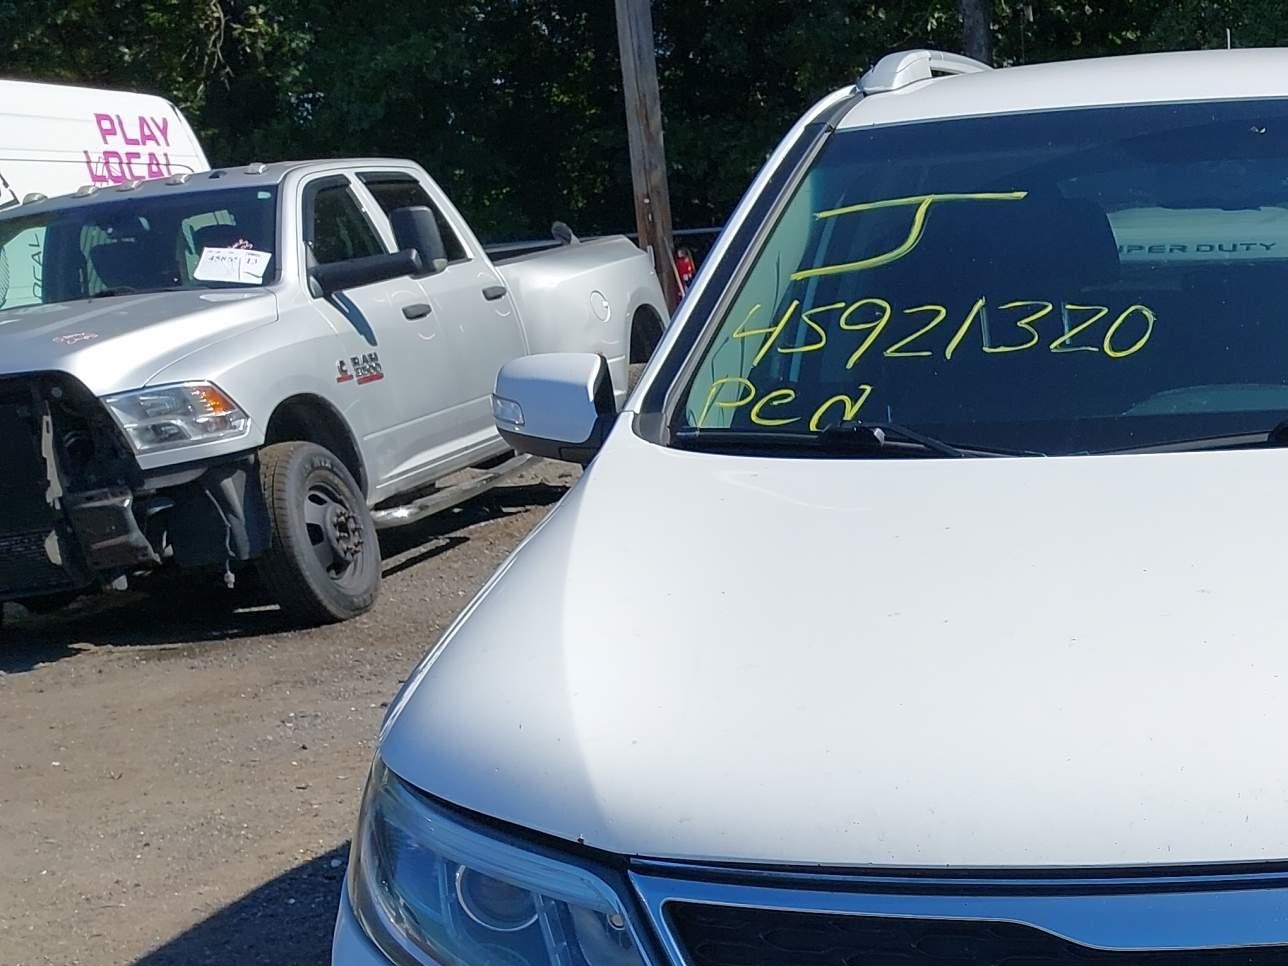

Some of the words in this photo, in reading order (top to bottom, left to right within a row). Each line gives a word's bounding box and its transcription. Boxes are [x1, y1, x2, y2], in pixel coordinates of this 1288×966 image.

[94, 113, 170, 147] PLAY
[790, 190, 1028, 280] J
[1118, 243, 1188, 254] PER
[1196, 242, 1277, 253] DUTY
[733, 296, 1156, 370] 45921320
